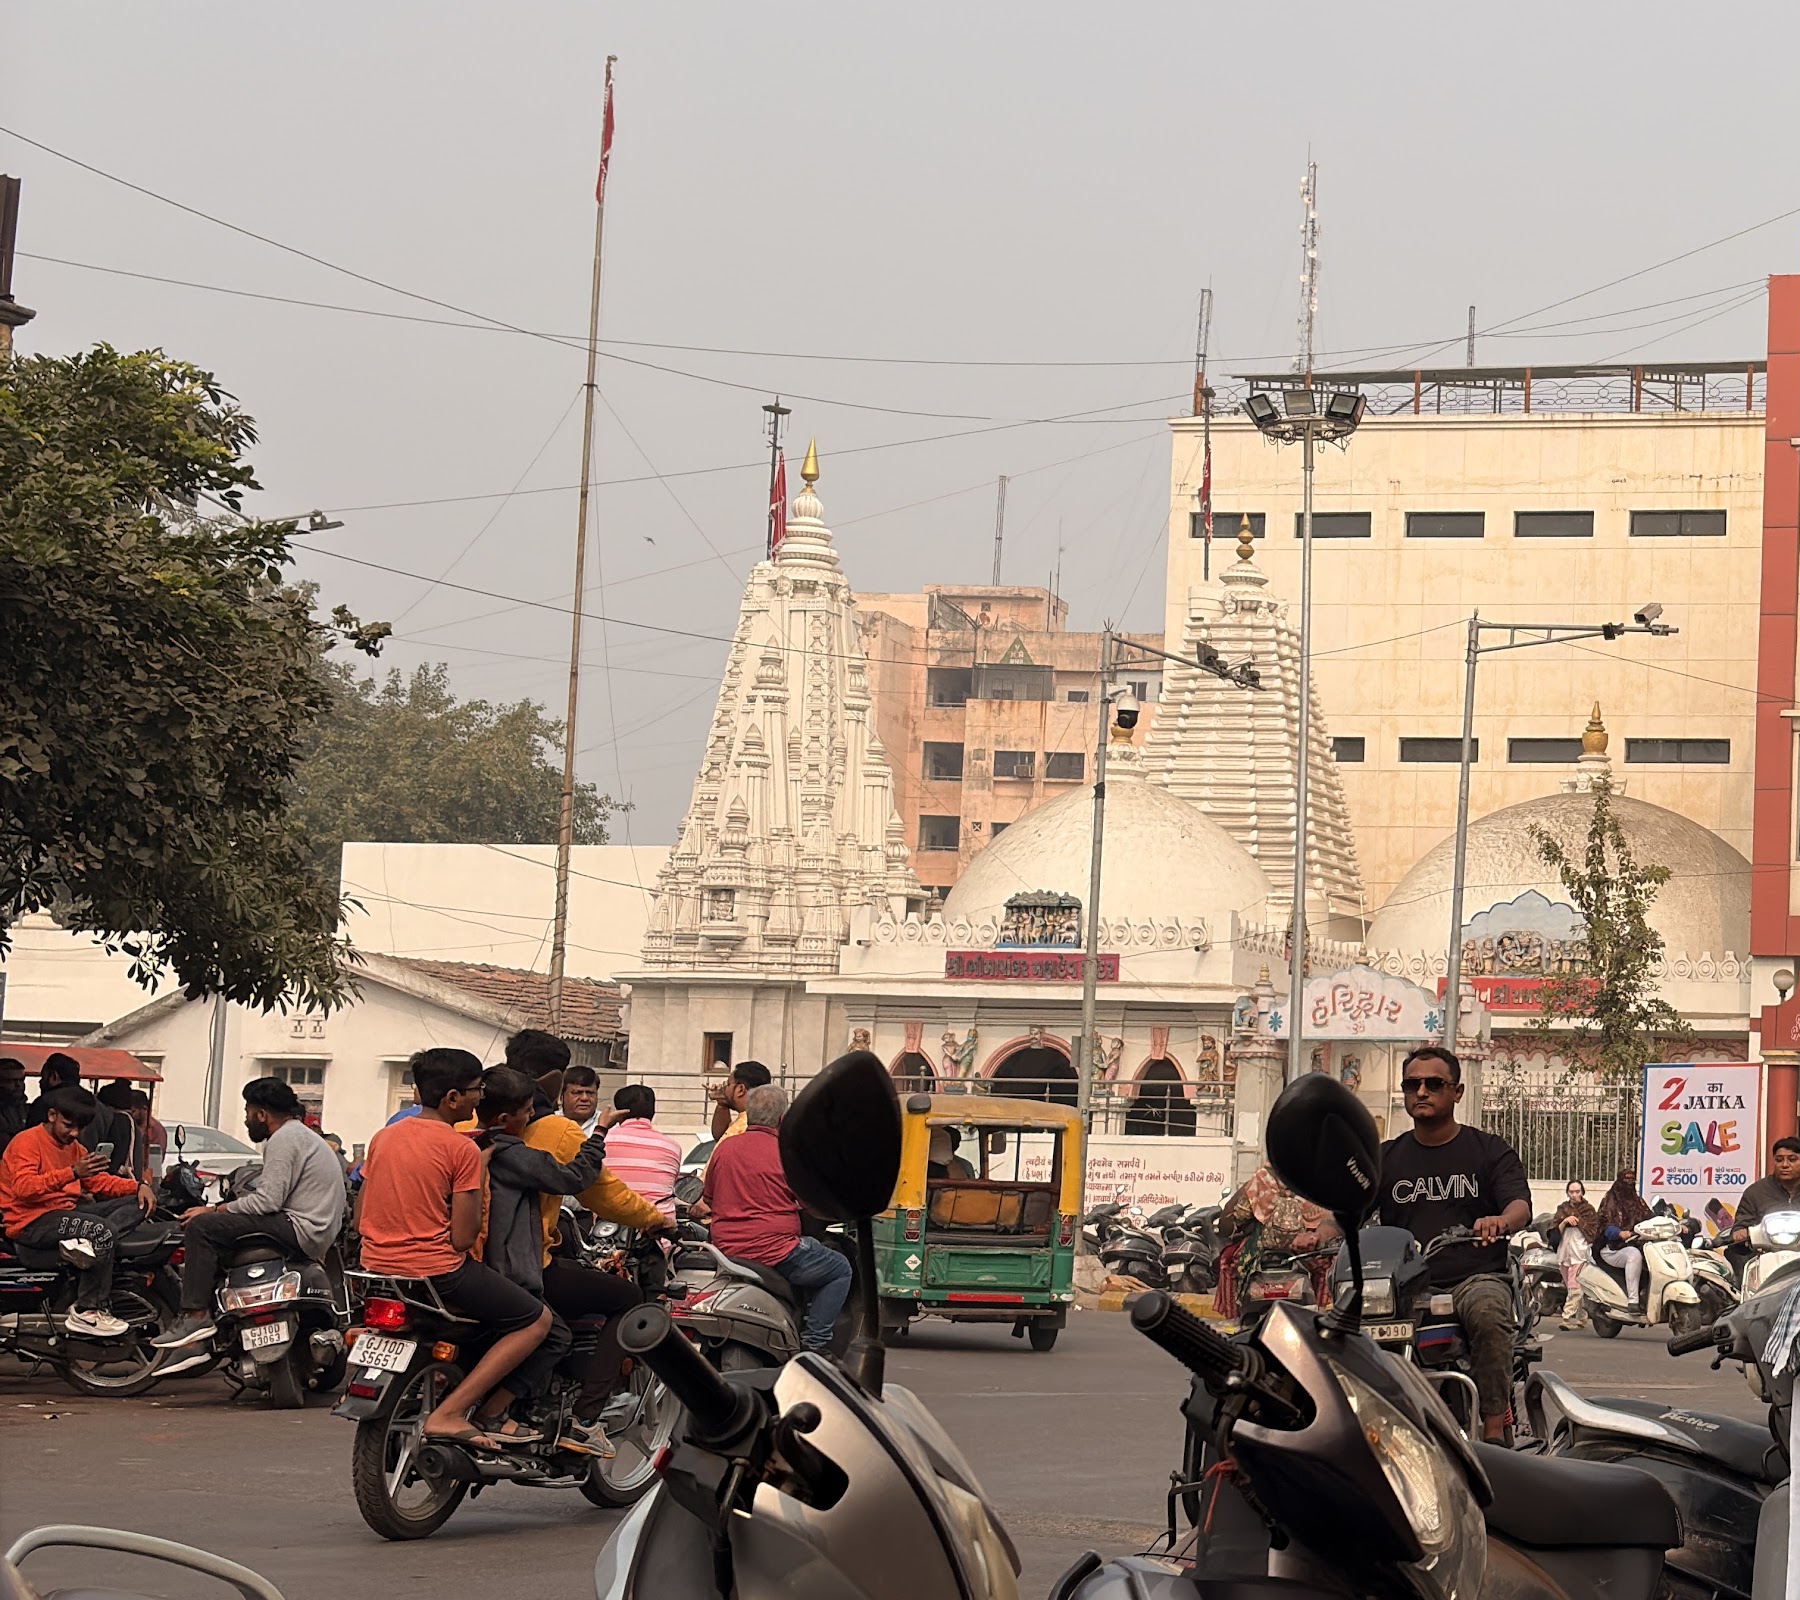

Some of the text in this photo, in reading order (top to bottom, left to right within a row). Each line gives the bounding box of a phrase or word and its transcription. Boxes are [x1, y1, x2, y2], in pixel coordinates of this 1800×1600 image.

[946, 953, 964, 977] શ્રી
[1658, 1077, 1689, 1112] 2
[1707, 1083, 1724, 1094] का
[1683, 1095, 1746, 1110] JATKA
[1660, 1120, 1741, 1156] SALE
[1651, 1167, 1697, 1185] 2 ₹500
[1703, 1167, 1747, 1185] 1 ₹300
[1391, 1173, 1479, 1204] CALVIN
[250, 1322, 281, 1338] GJ10D
[251, 1334, 282, 1348] K3063
[364, 1336, 405, 1357] GJ10D
[358, 1350, 399, 1369] S5651
